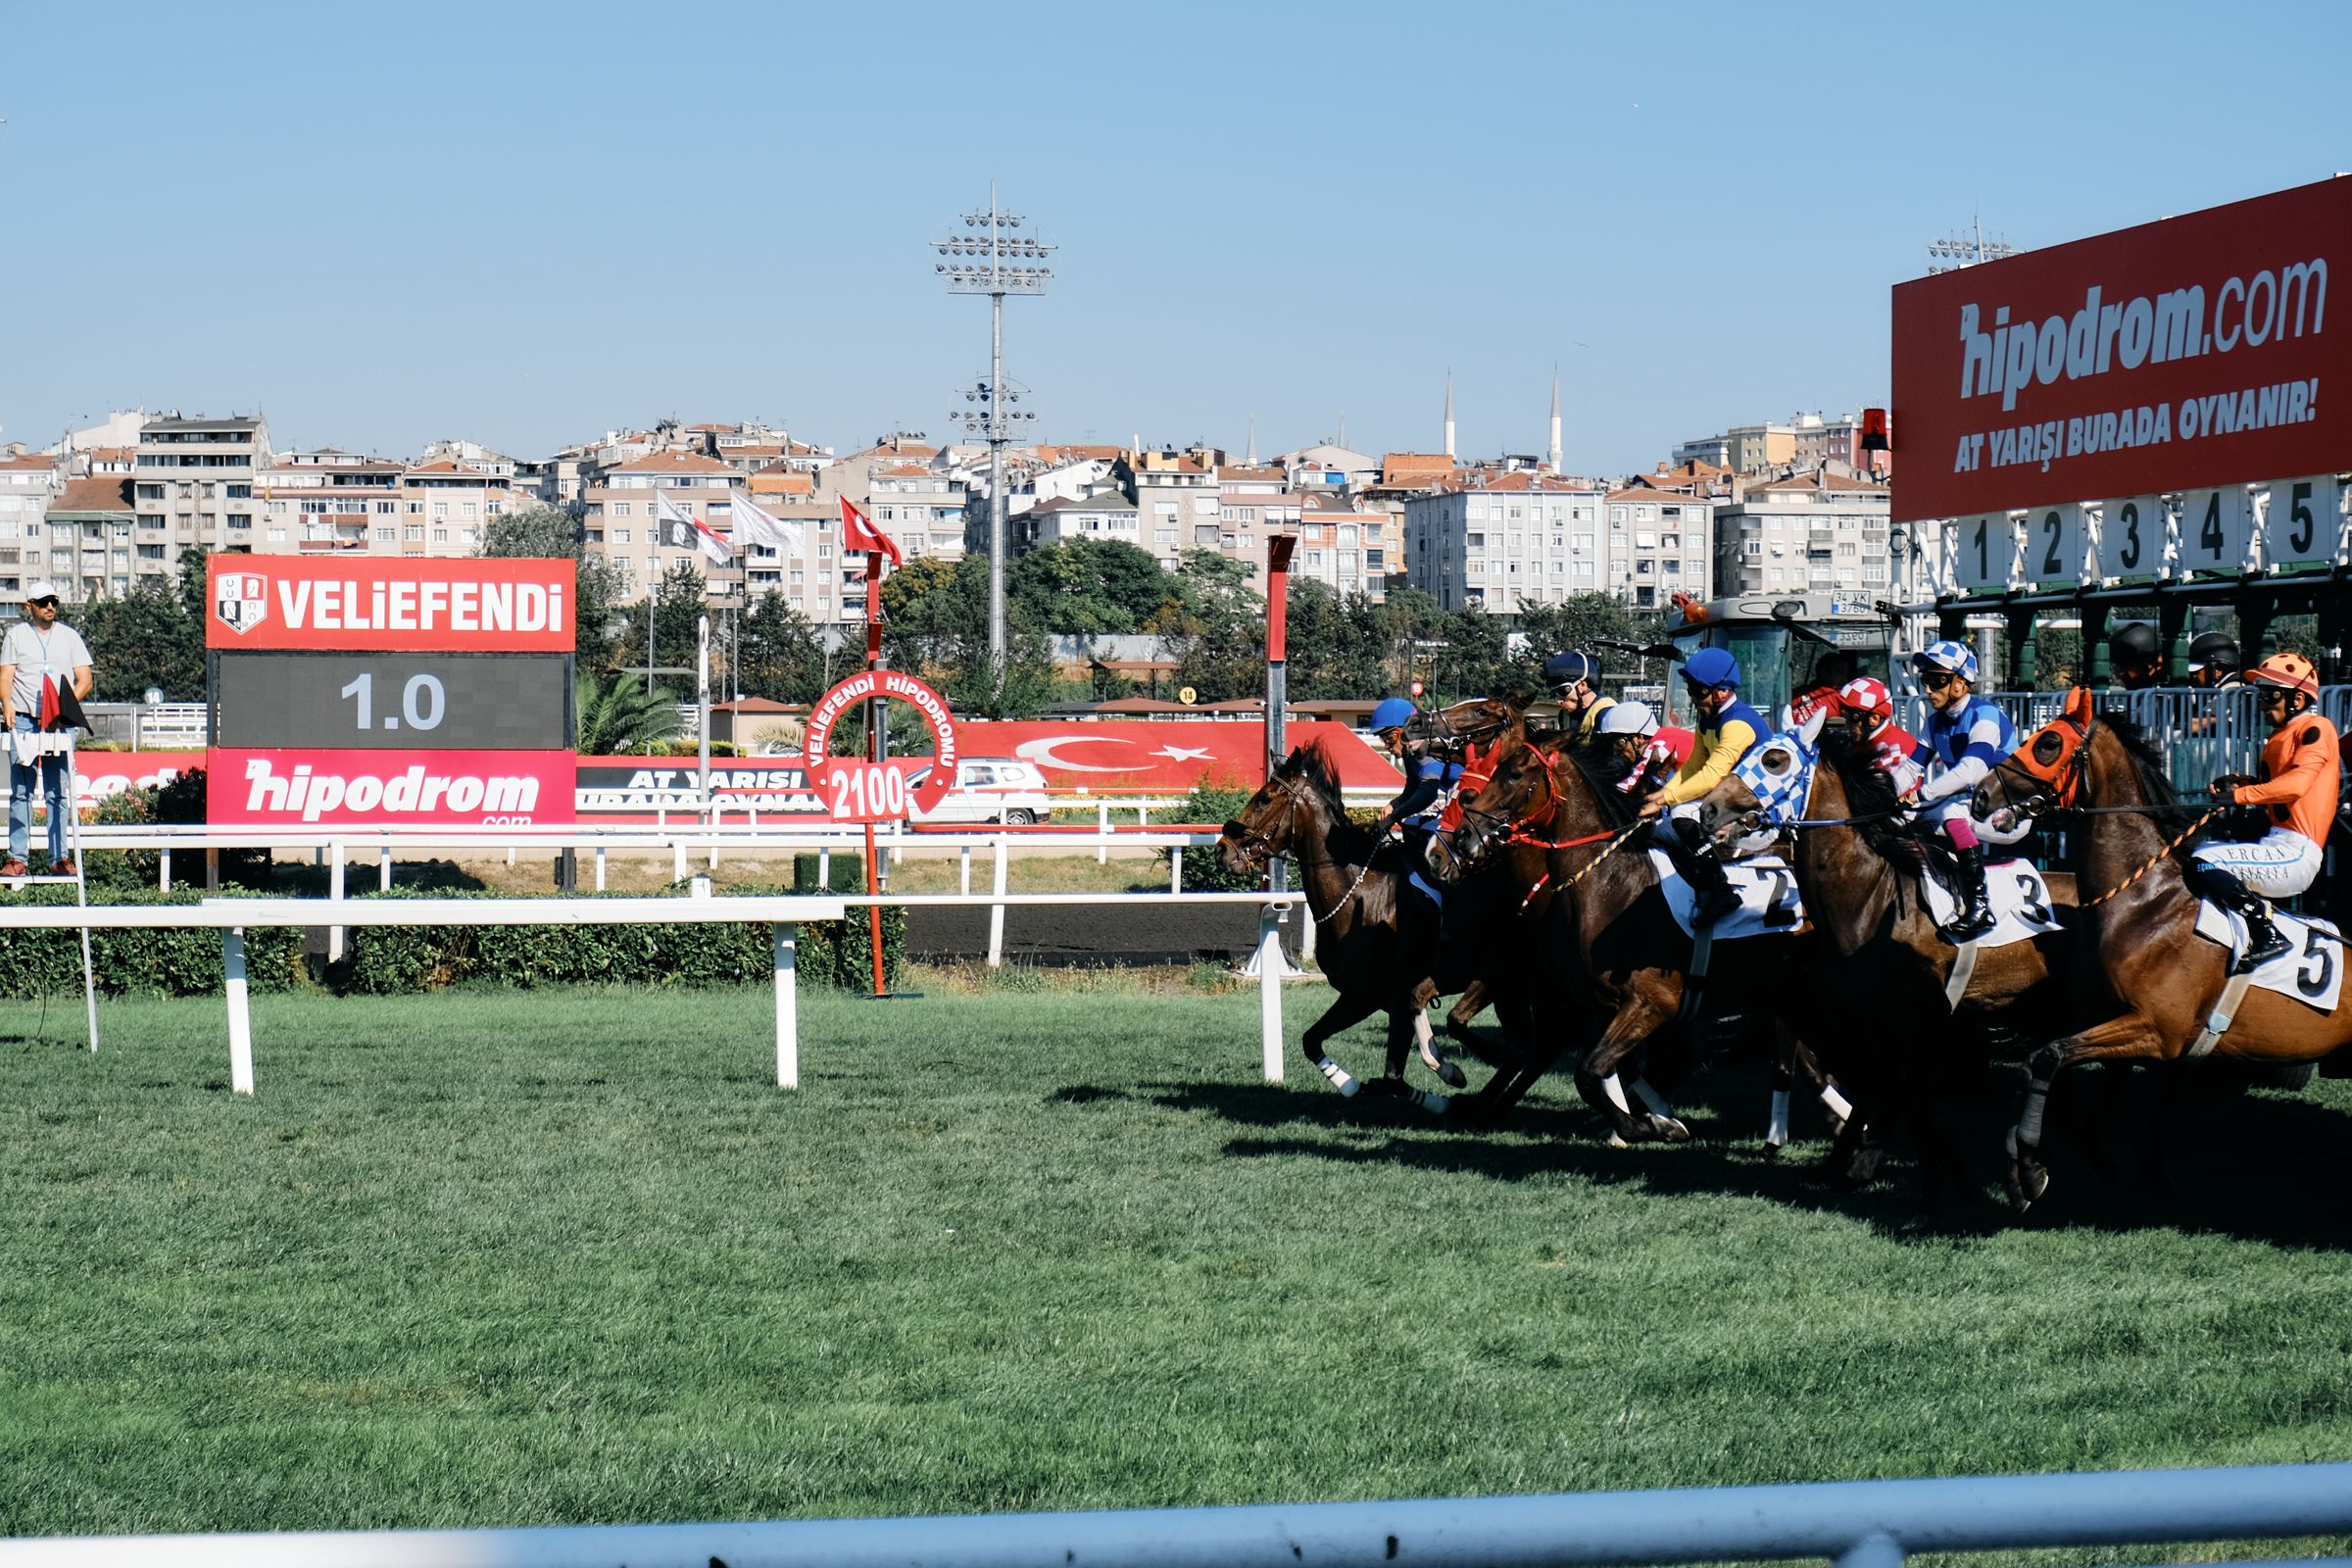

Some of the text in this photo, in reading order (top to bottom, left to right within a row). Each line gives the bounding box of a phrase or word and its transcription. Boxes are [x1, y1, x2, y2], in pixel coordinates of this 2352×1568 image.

[1960, 258, 2328, 412] hipodrom.com
[1954, 377, 2320, 473] AT YARIŞI BURADA OYNANIR!
[2043, 511, 2062, 575] 2
[2120, 503, 2140, 568] 3
[2200, 492, 2224, 560] 4
[2289, 483, 2314, 554] 5
[1974, 519, 1988, 580] 1
[341, 673, 446, 730] 1.0
[885, 676, 956, 768] HİPODROMU
[1183, 691, 1194, 701] 14
[245, 760, 540, 821] hipodrom
[627, 770, 676, 789] AT
[831, 765, 905, 818] 2100
[2226, 848, 2287, 861] ERCAN
[1755, 867, 1797, 928] 2
[2015, 874, 2052, 925] 3
[2297, 927, 2337, 998] 5
